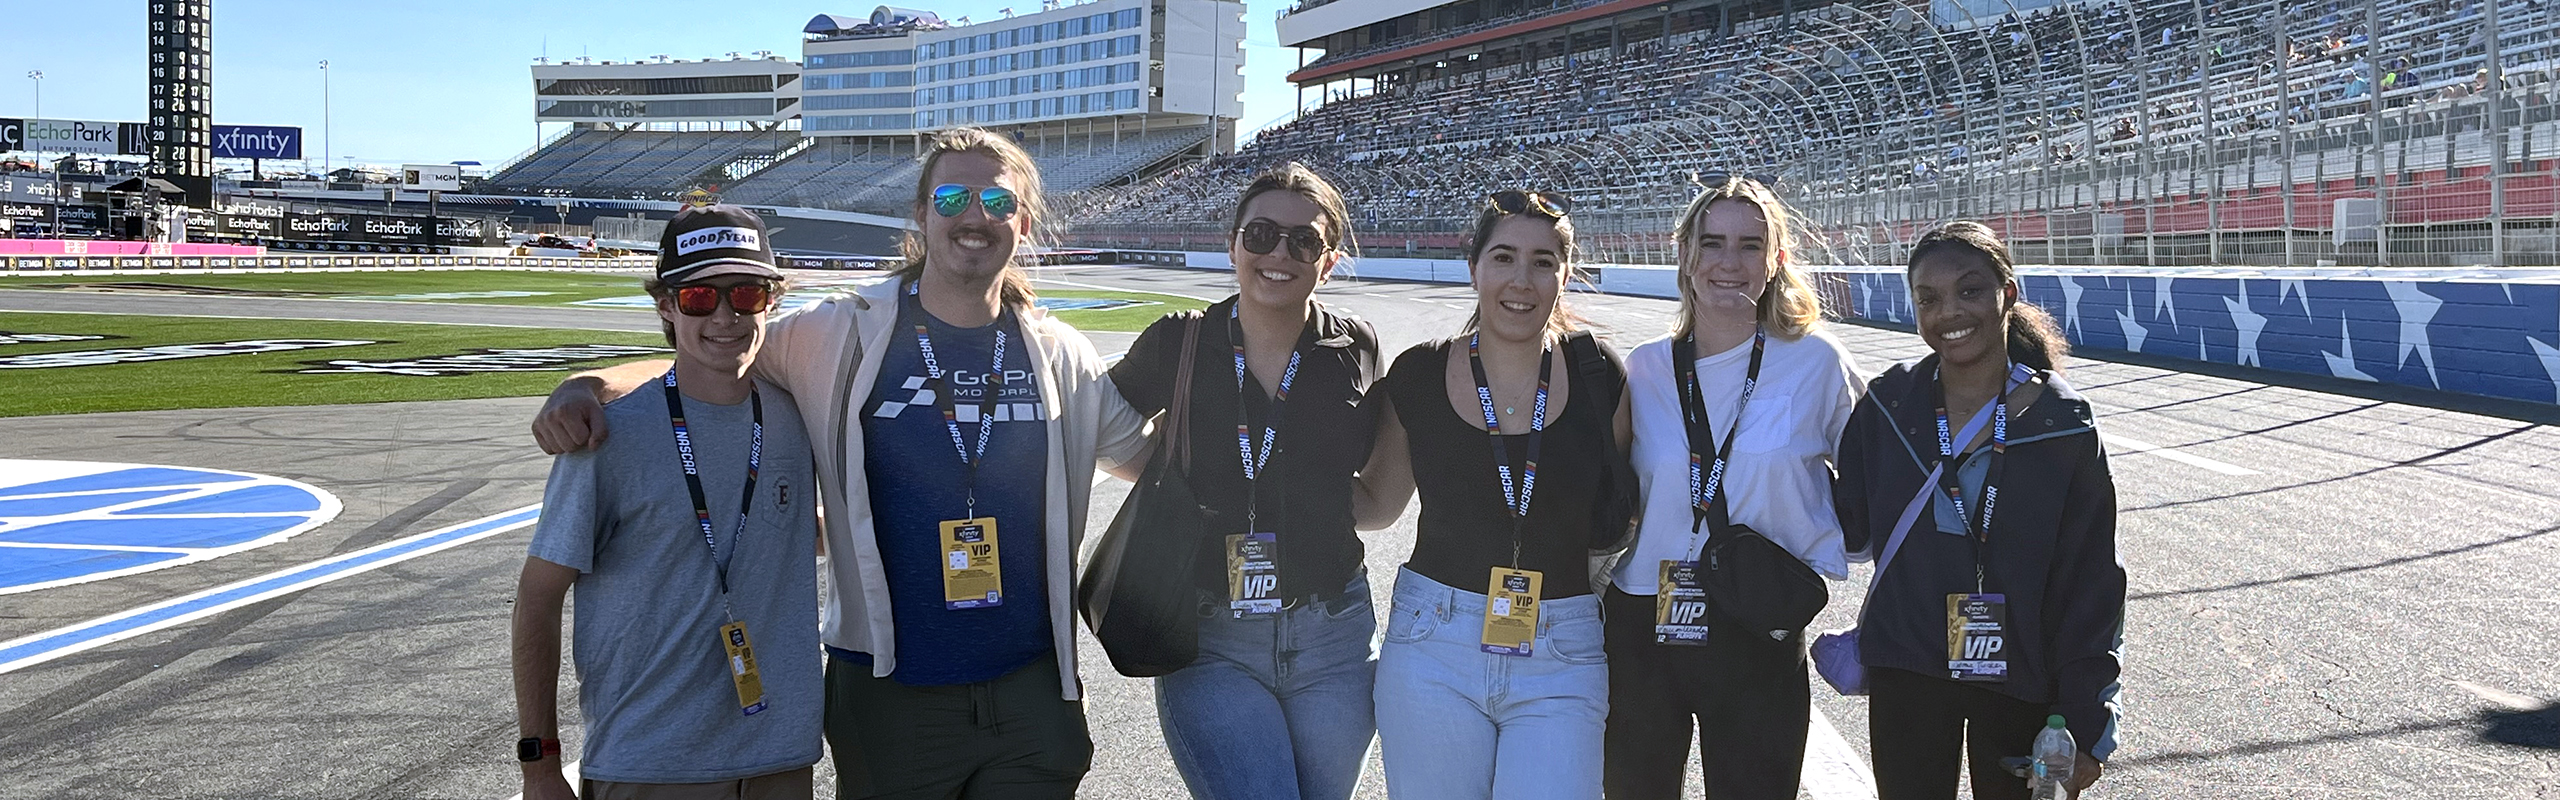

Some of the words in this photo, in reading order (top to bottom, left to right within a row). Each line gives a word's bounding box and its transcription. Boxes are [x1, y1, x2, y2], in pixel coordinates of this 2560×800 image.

[153, 4, 164, 14] 12
[190, 5, 199, 17] 12
[153, 21, 164, 31] 13
[153, 36, 164, 46] 14
[153, 53, 164, 63] 15
[153, 67, 164, 78] 16
[153, 85, 164, 95] 17
[172, 83, 185, 97] 32
[153, 99, 164, 109] 18
[172, 98, 185, 111] 26
[153, 116, 164, 126] 19
[28, 121, 112, 142] EchoPark
[153, 130, 164, 141] 20
[42, 145, 98, 153] AUTOMOTIVE
[218, 127, 290, 157] xfinity
[421, 173, 457, 182] BETMGM
[680, 194, 718, 203] SUNOCO
[3, 204, 44, 217] EchoPark
[58, 208, 97, 219] EchoPark
[228, 217, 270, 230] EchoPark
[290, 217, 349, 231] EchoPark
[365, 219, 422, 235] EchoPark
[680, 230, 756, 248] GOODYEAR
[845, 261, 876, 269] BETMGM
[918, 338, 941, 379] NASCAR
[992, 330, 1007, 372] NASCAR
[1281, 351, 1302, 391] NASCAR
[1478, 386, 1497, 424] NASCAR
[1531, 391, 1547, 432] NASCAR
[1993, 403, 2006, 441] NASCAR
[976, 413, 994, 456] NASCAR
[1936, 419, 1951, 456] NASCAR
[675, 431, 697, 475] NASCAR
[750, 422, 763, 468] NASCAR
[1257, 426, 1277, 470] NASCAR
[1239, 438, 1254, 480] NASCAR
[1499, 465, 1516, 506] NASCAR
[1704, 457, 1726, 501] NASCAR
[779, 485, 788, 504] E
[1519, 474, 1535, 517] NASCAR
[1982, 486, 1998, 530] NASCAR
[971, 544, 991, 556] VIP
[1673, 571, 1695, 580] xfinity
[1244, 574, 1277, 599] VIP
[1515, 595, 1533, 607] VIP
[1671, 601, 1706, 624] VIP
[1964, 605, 1988, 614] xfinity
[1657, 634, 1666, 643] 12
[1964, 636, 2003, 659] VIP
